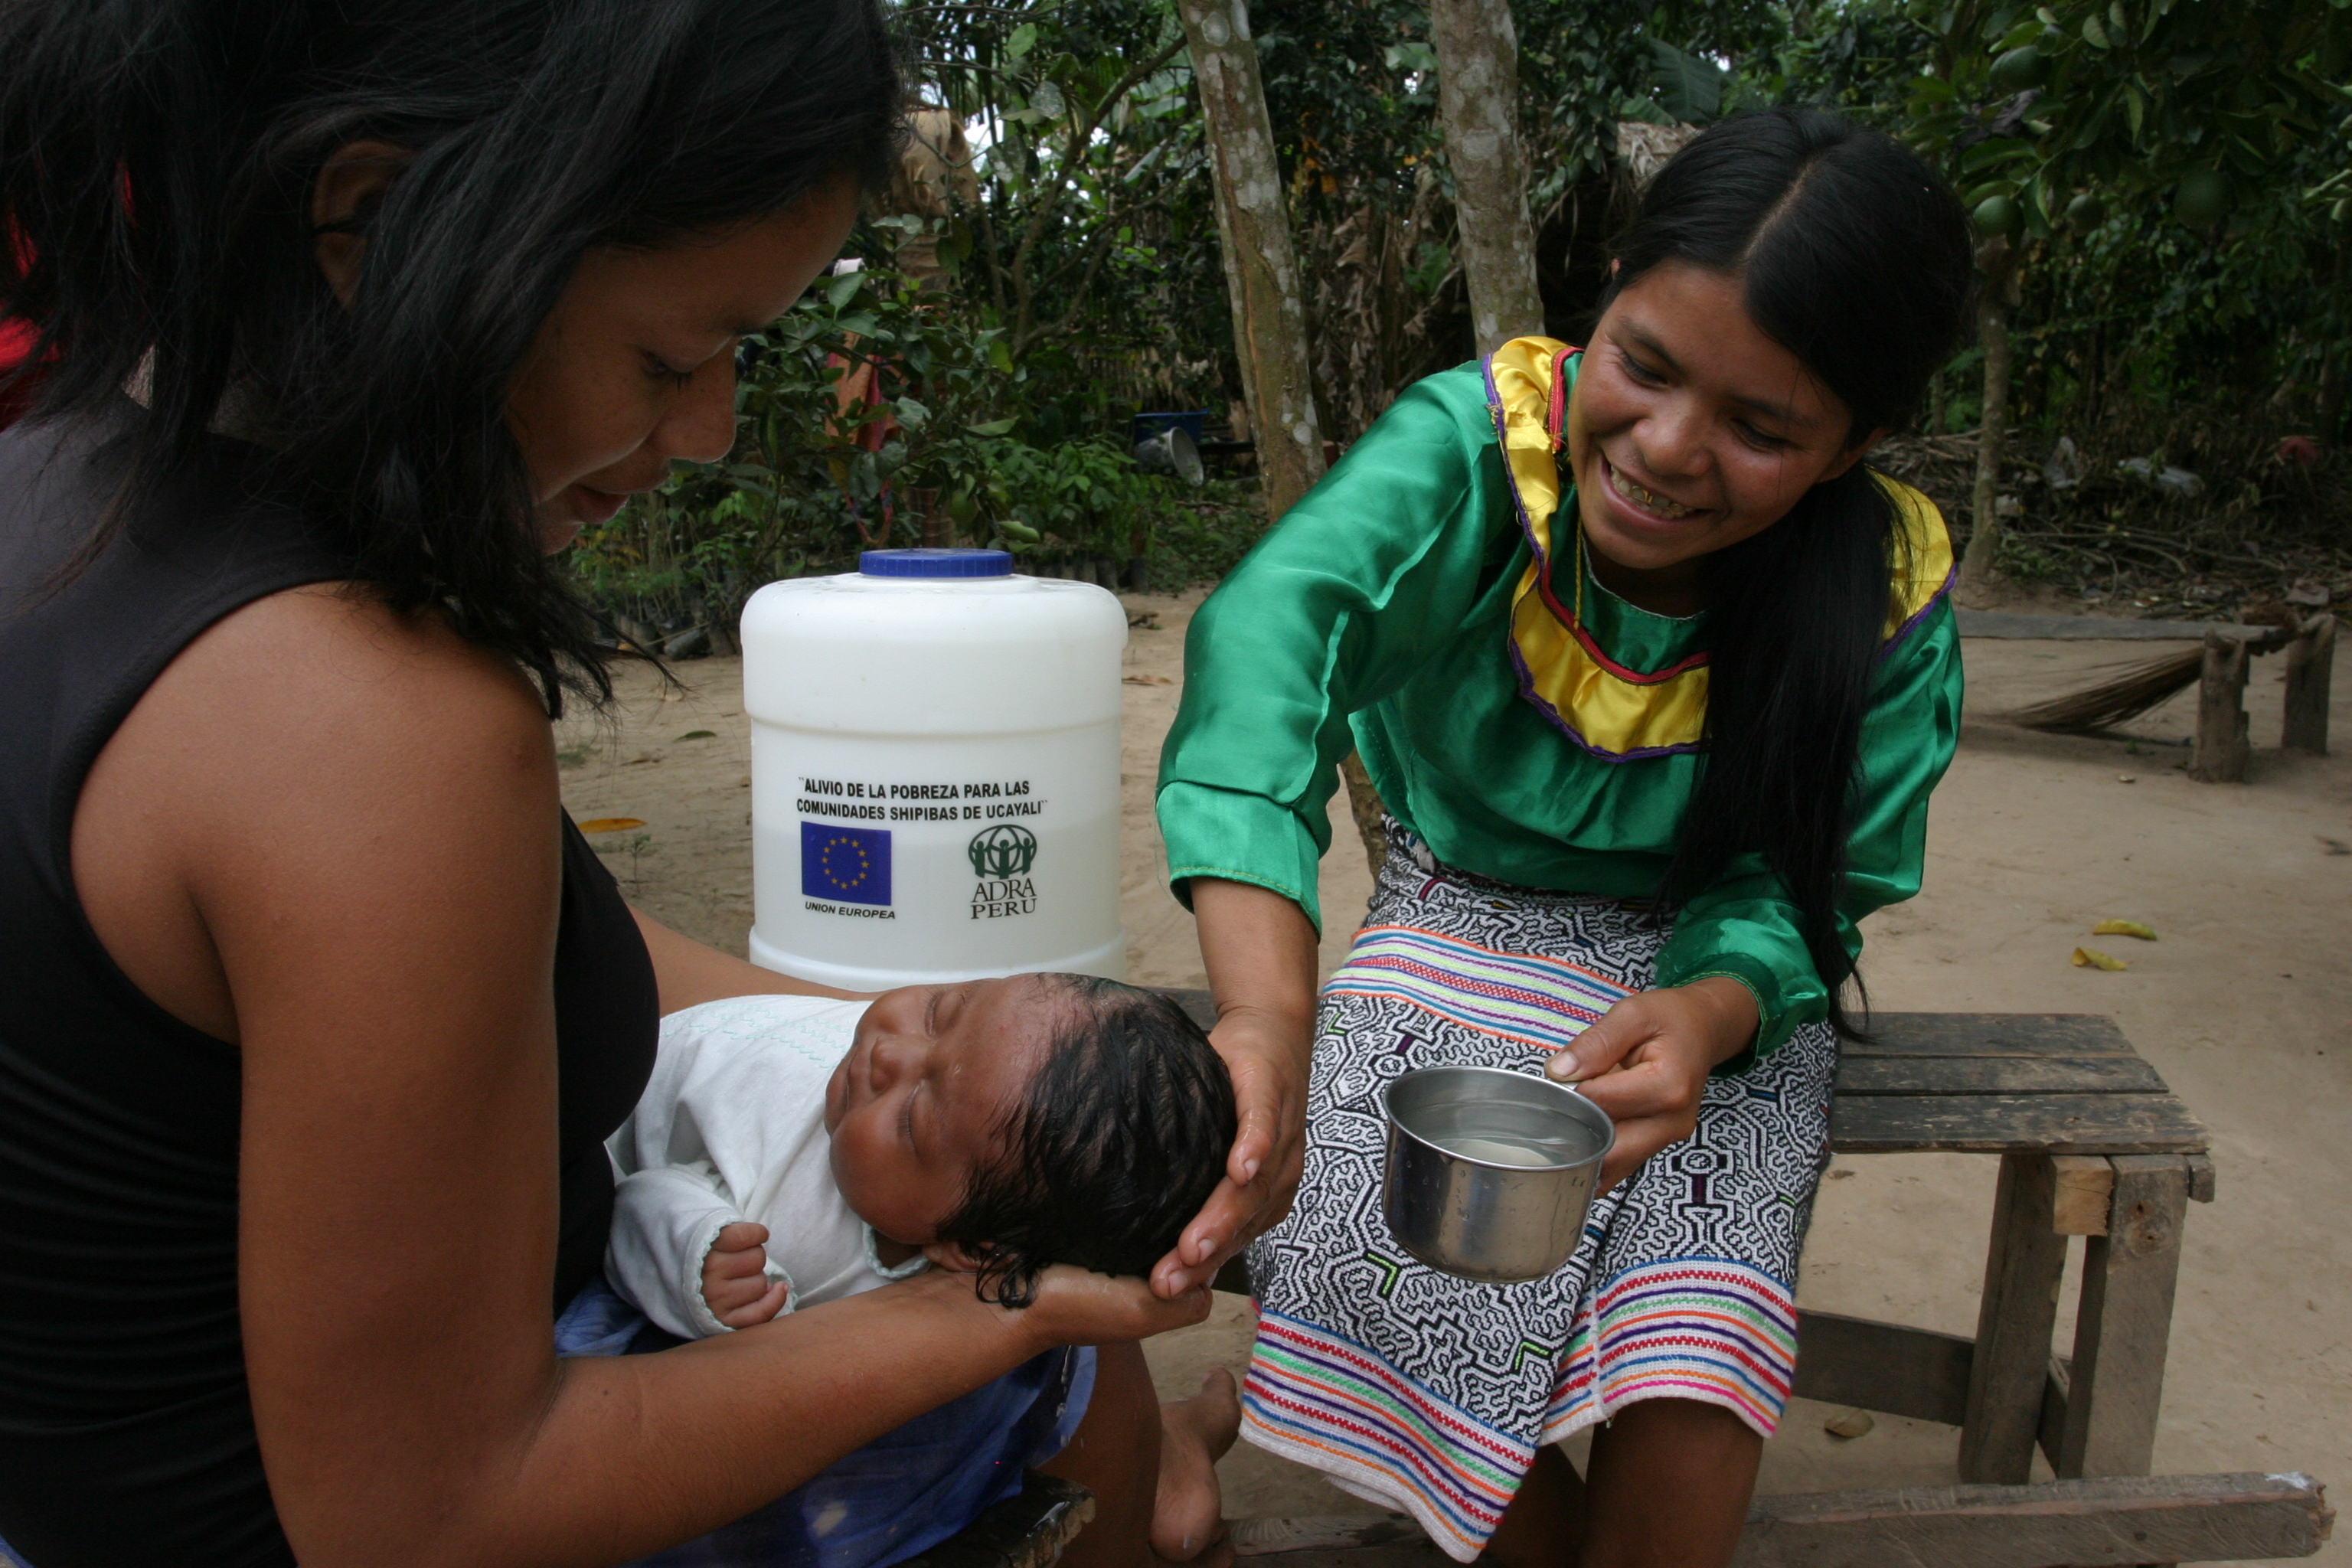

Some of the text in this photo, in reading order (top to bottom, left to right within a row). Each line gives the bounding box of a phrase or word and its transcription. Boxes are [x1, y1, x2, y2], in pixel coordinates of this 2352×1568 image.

[848, 782, 864, 798] DE
[869, 784, 886, 799] LA
[891, 785, 959, 799] POBREZA
[965, 782, 1001, 798] PARA
[1005, 781, 1030, 795] LAS
[797, 799, 885, 820] COMUNIDADES
[890, 806, 958, 821] SHIPIBAS
[963, 805, 981, 819] DE
[972, 878, 1037, 903] ADRA
[805, 902, 896, 920] UNION EUROPEA
[971, 899, 1037, 920] PERU
